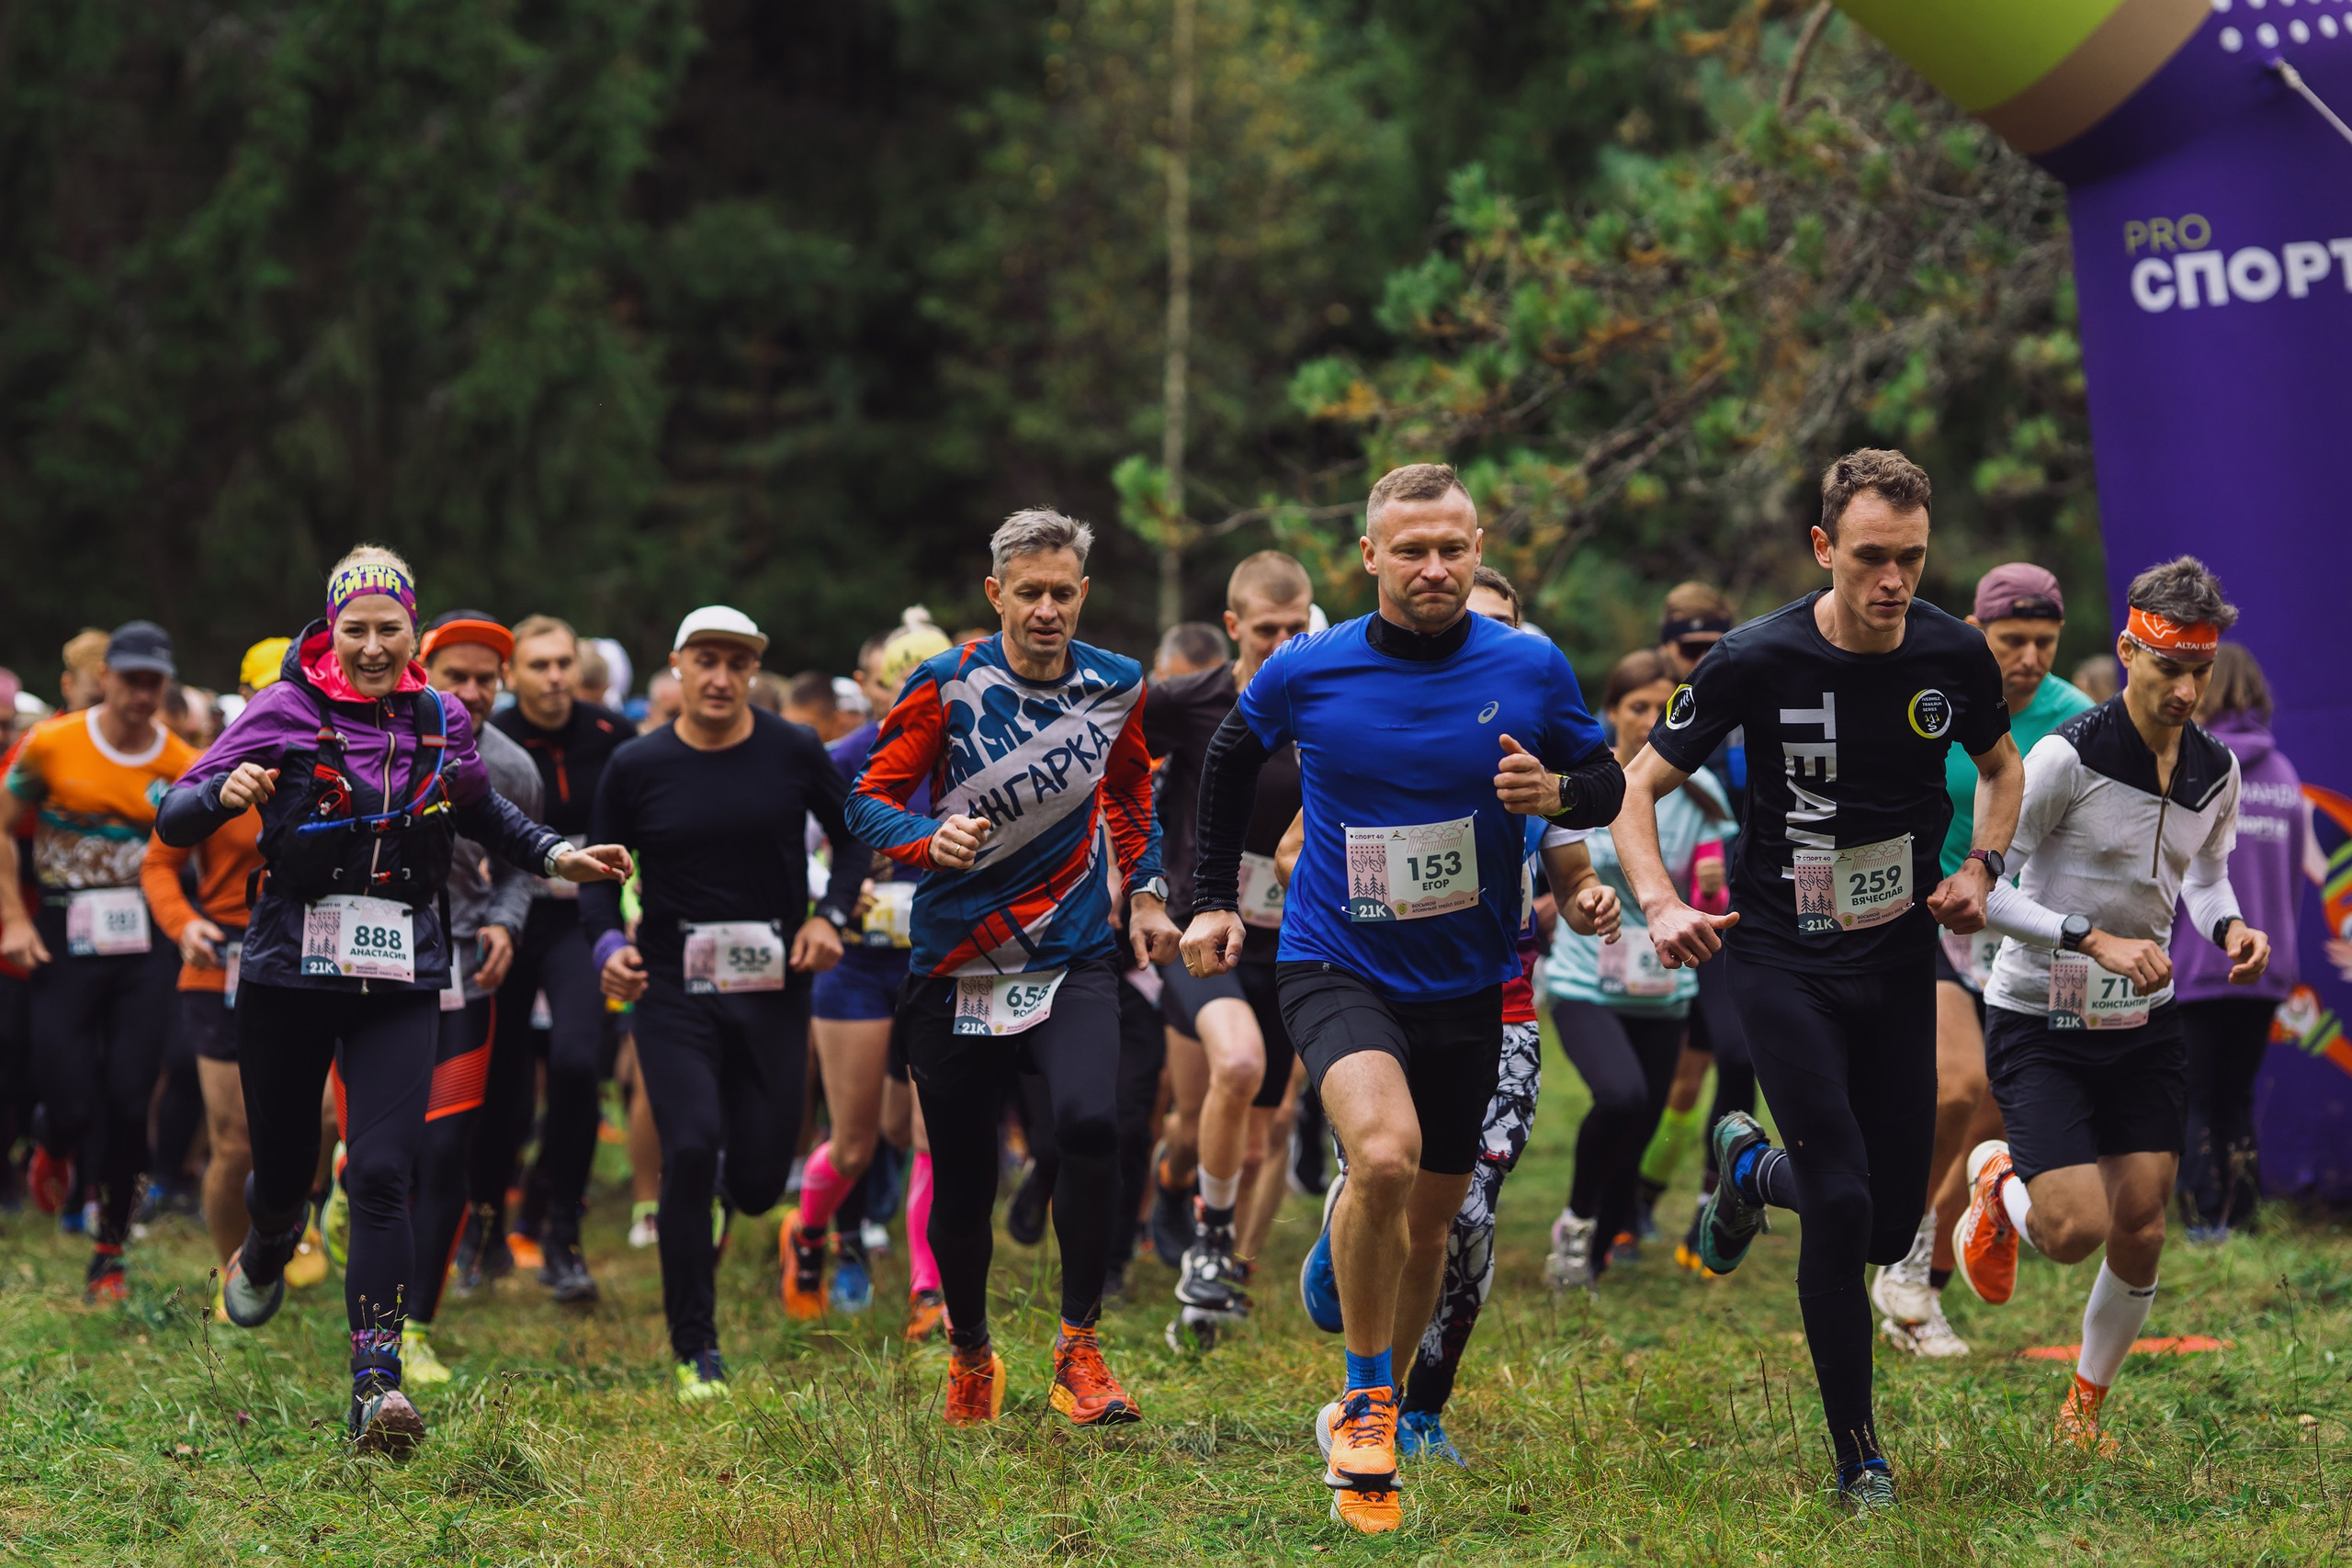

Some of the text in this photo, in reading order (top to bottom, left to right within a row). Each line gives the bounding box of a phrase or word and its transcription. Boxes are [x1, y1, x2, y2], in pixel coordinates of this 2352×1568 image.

[2123, 213, 2212, 256] PRO
[334, 571, 401, 607] СИЛА
[2175, 641, 2199, 649] ALTAI
[968, 720, 1111, 832] АНГАРКА
[1408, 851, 1463, 882] 153
[1422, 879, 1450, 891] ЕГОР
[1849, 865, 1902, 897] 259
[1411, 900, 1437, 908] ВОСЬМОЙ
[1851, 886, 1904, 907] ВЯЧЕСЛАВ
[354, 925, 402, 950] 888
[349, 948, 407, 961] АНАСТАСИЯ
[728, 947, 772, 967] 535
[2101, 977, 2137, 999] 71
[2091, 997, 2149, 1010] КОНСТАНТИН
